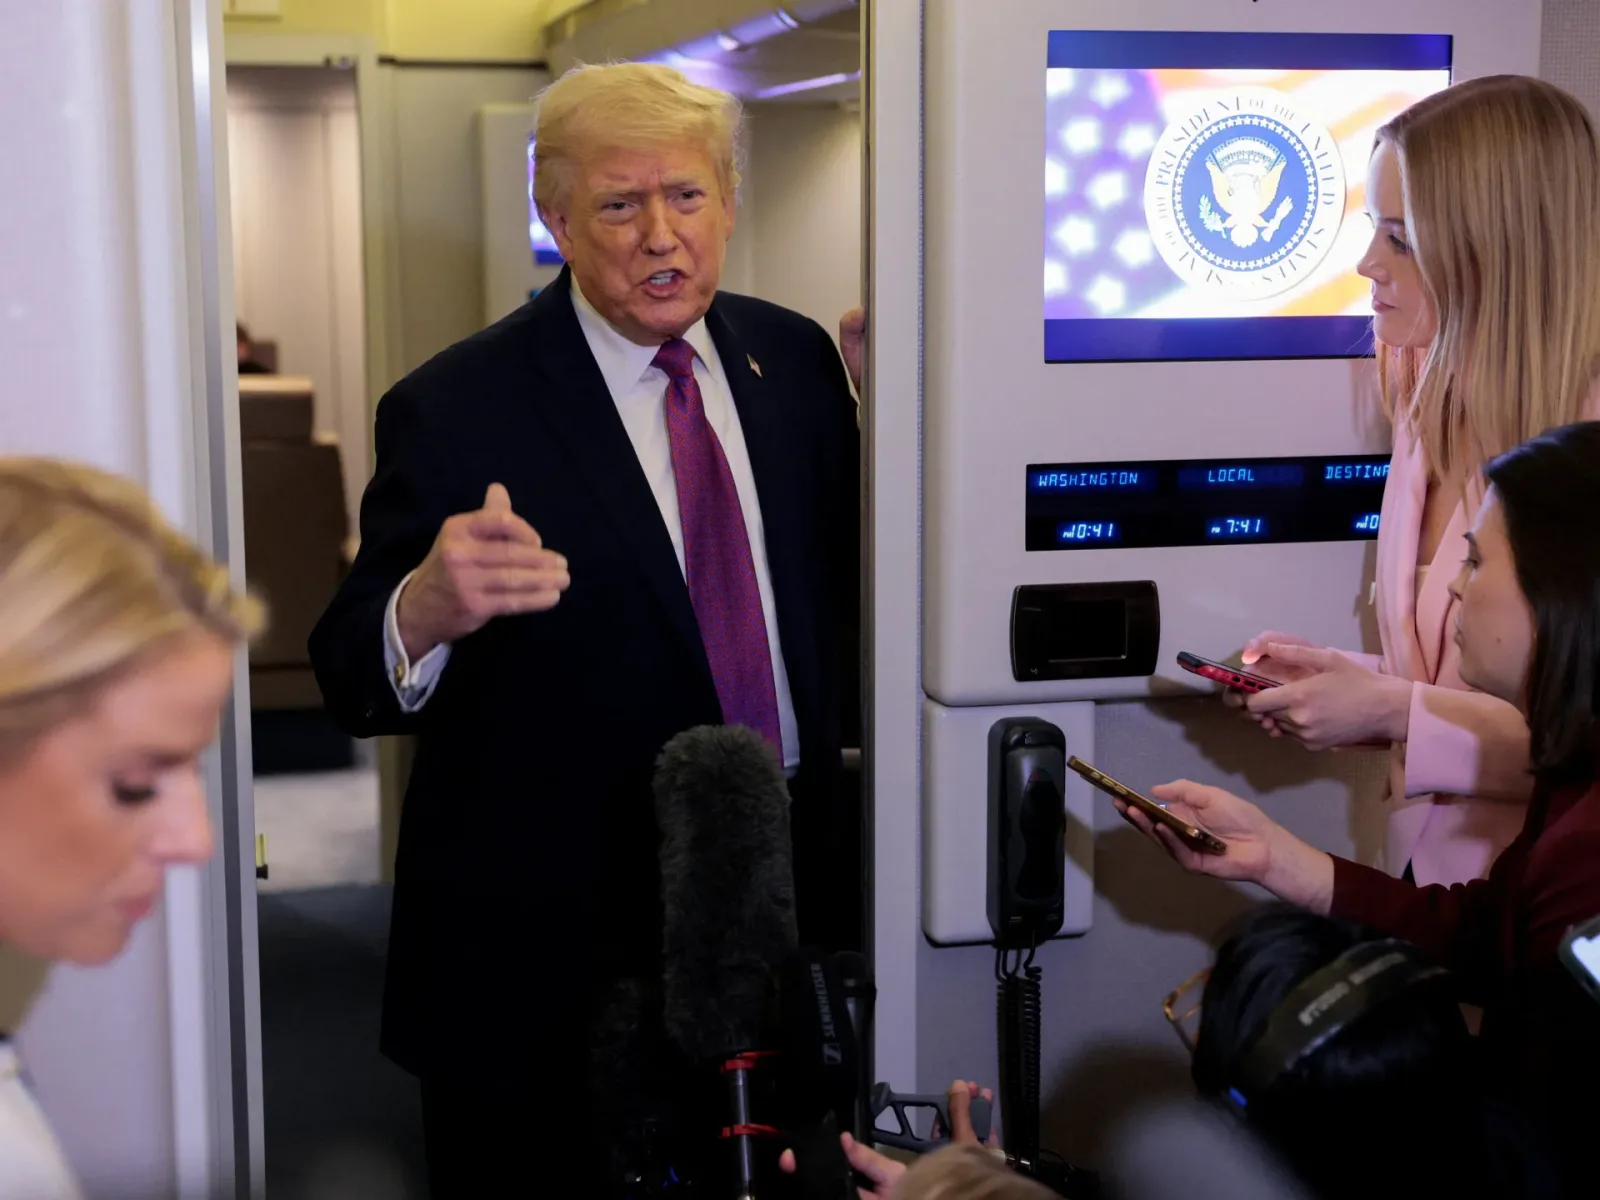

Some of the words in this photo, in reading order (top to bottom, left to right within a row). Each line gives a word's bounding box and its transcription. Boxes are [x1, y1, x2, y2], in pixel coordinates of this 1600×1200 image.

[1154, 95, 1244, 186] PRESIDENT
[1039, 472, 1138, 487] WASHINGTON
[1208, 468, 1255, 482] LOCAL
[1071, 523, 1113, 538] 10:41
[1226, 519, 1261, 534] 7:41
[810, 962, 836, 1038] SENNHEISER
